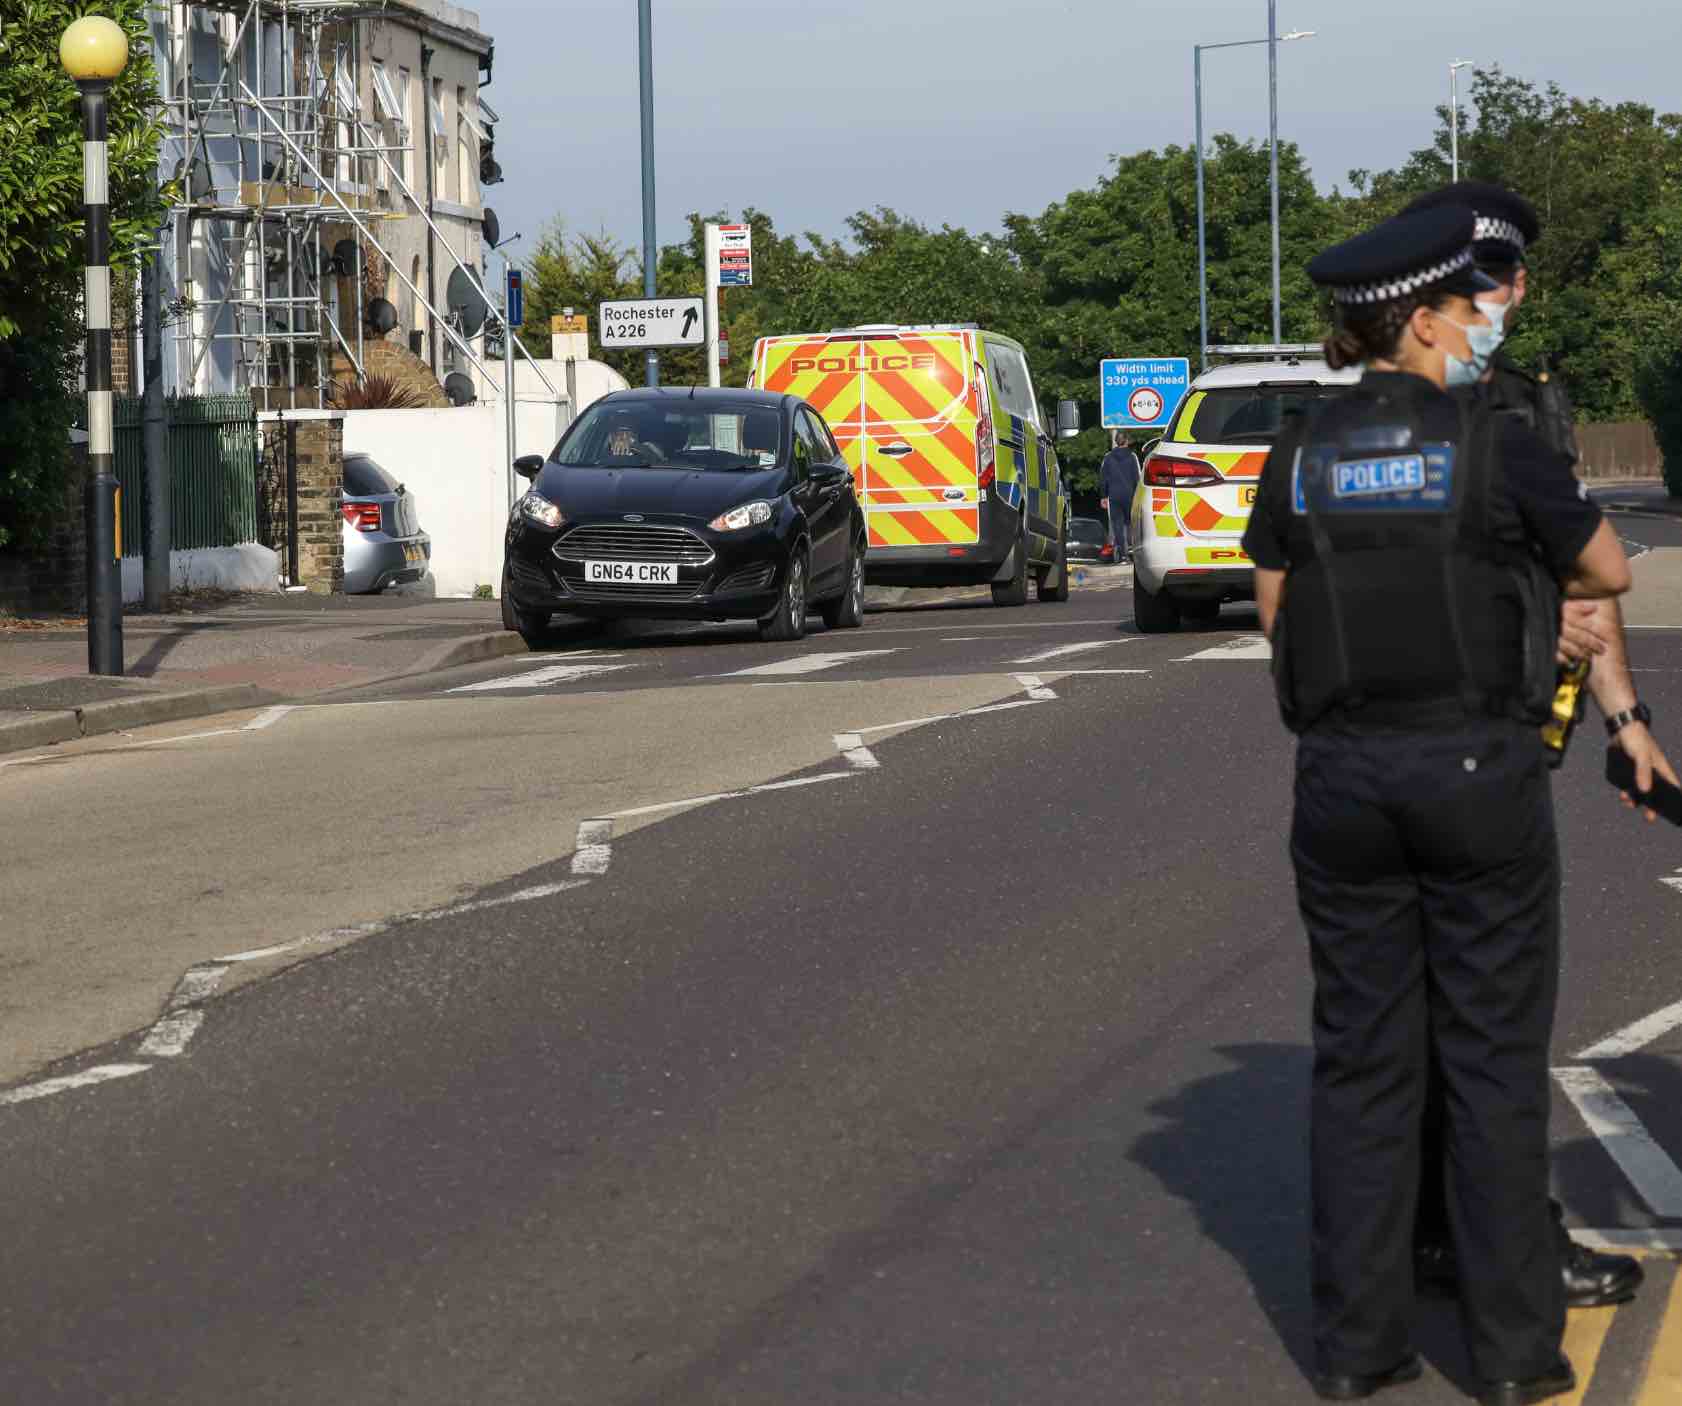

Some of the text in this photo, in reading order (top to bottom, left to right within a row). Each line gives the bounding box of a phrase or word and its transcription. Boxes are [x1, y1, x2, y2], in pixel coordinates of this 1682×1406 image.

[605, 306, 674, 320] Rochester
[791, 355, 934, 374] POLICE
[1116, 362, 1174, 374] Width limit
[1105, 375, 1185, 386] 330 yds ahead
[1340, 460, 1417, 491] POLICE
[592, 564, 670, 581] GN64 CRK
